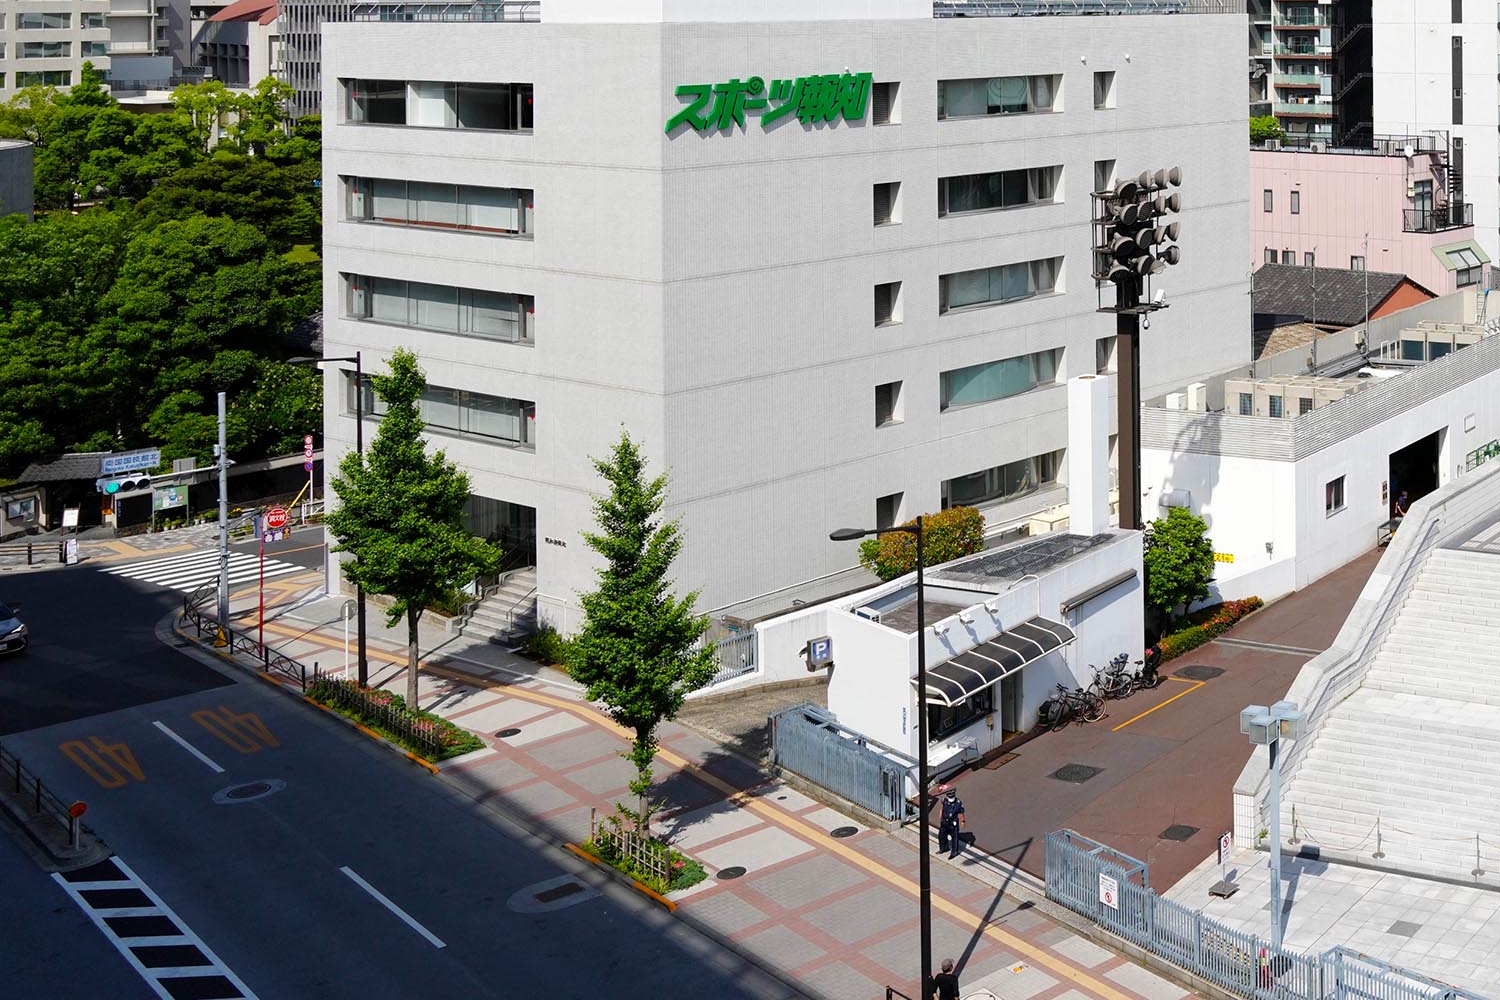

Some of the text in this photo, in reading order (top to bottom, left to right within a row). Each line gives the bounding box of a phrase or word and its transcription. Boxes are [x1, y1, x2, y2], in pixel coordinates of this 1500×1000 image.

[664, 72, 872, 134] スポーツ報知
[105, 453, 158, 466] 両国国技館北
[268, 513, 286, 523] 消火栓
[816, 642, 827, 655] P
[190, 705, 281, 754] 40
[58, 736, 146, 789] 40
